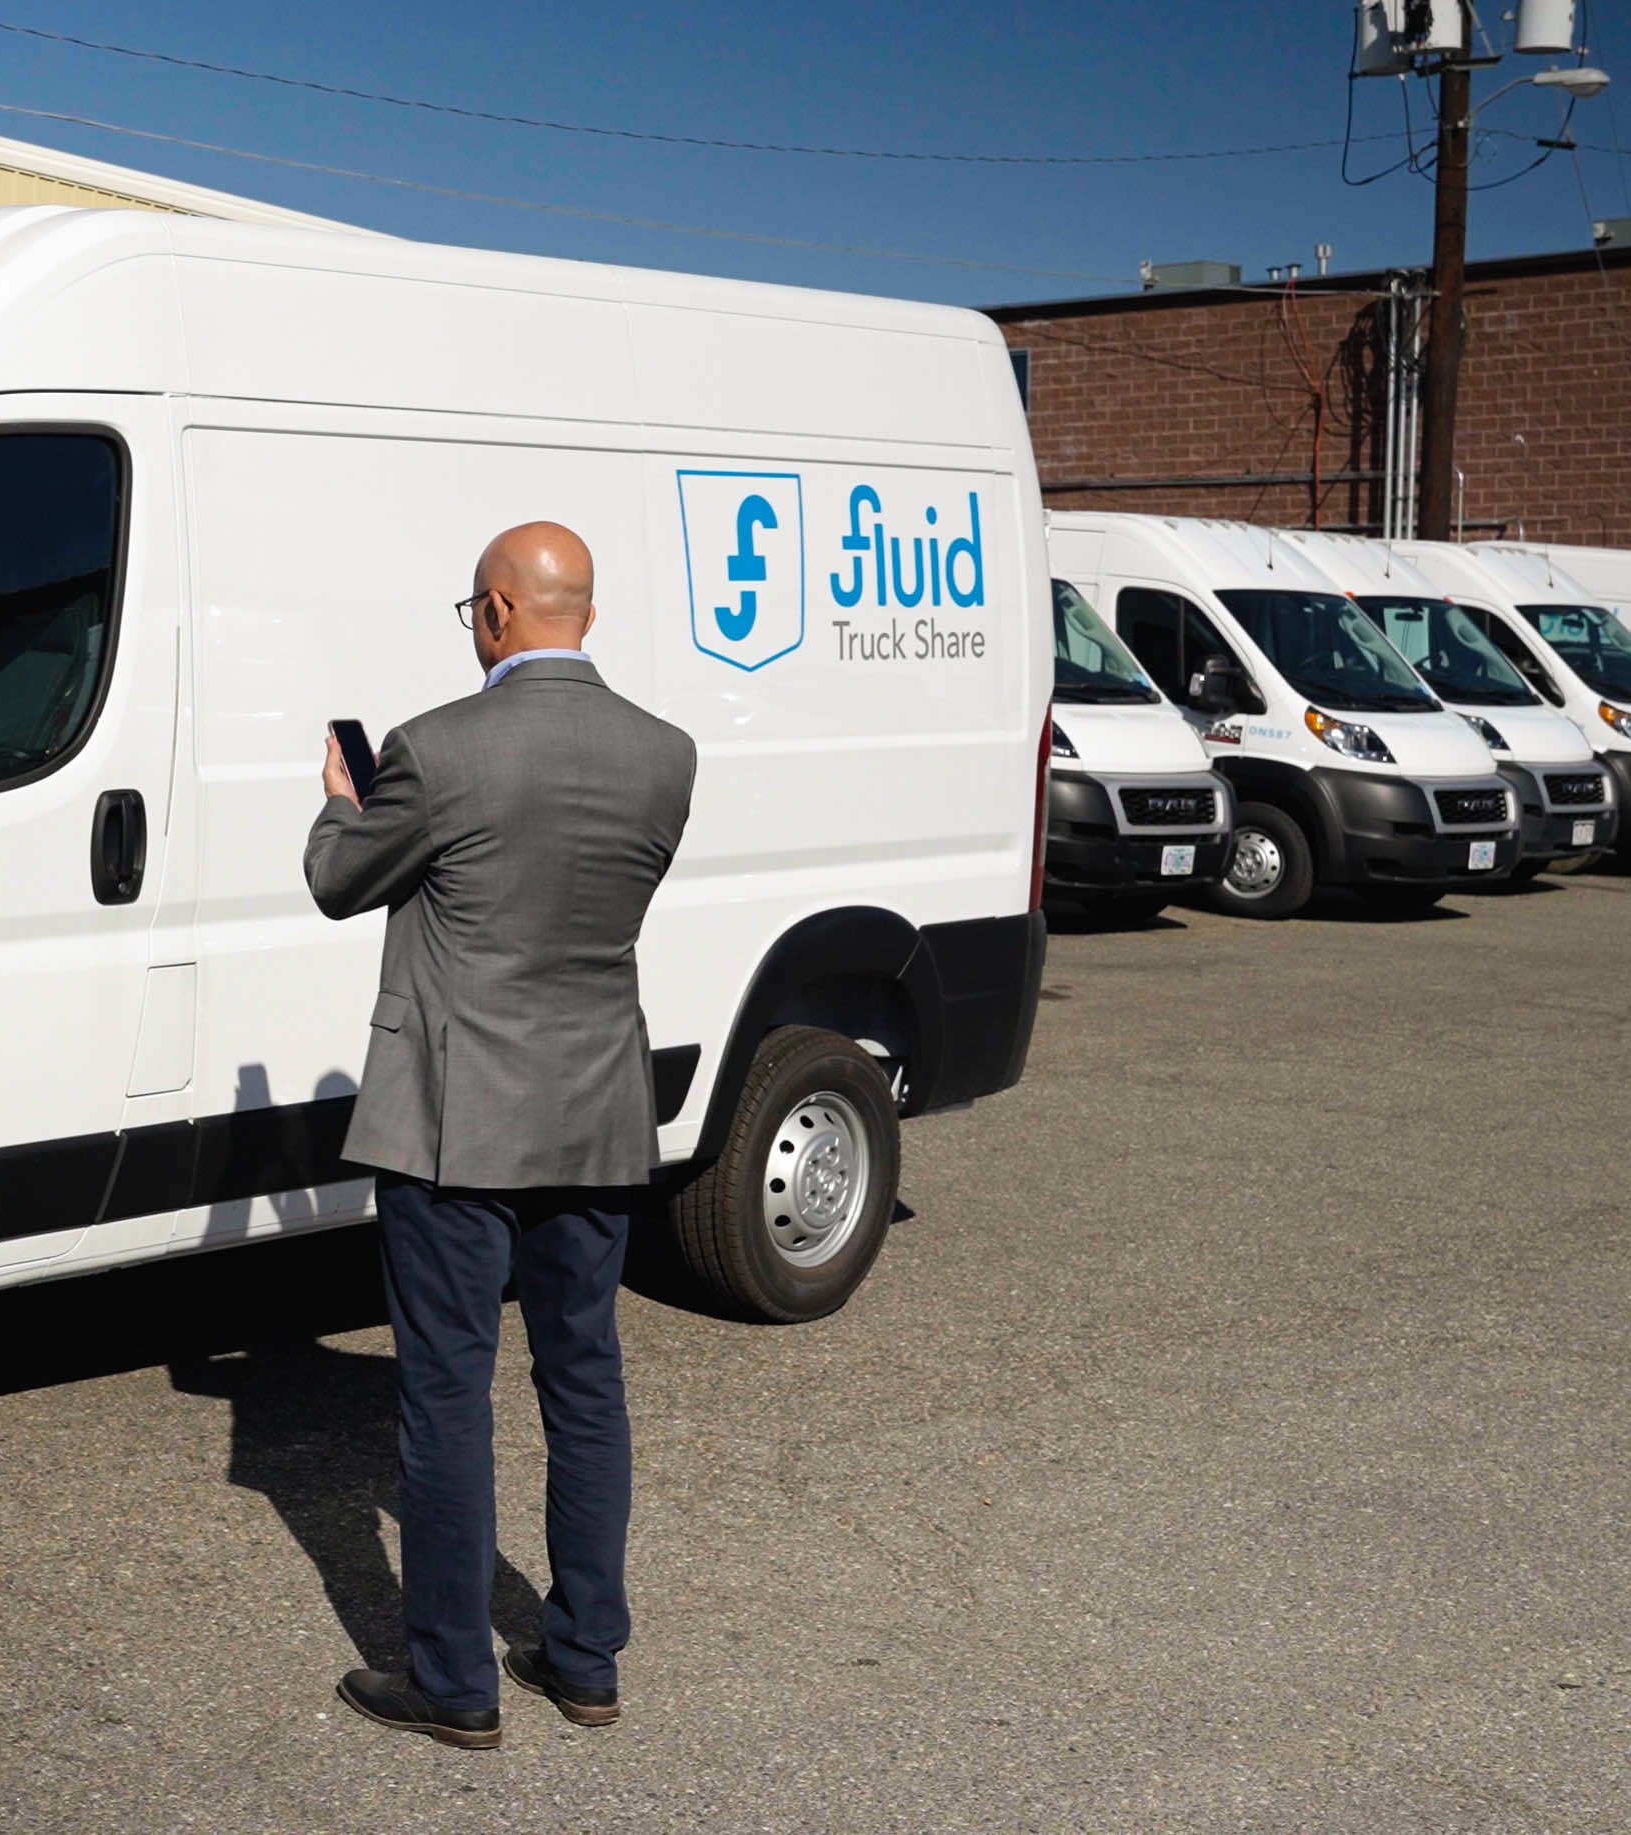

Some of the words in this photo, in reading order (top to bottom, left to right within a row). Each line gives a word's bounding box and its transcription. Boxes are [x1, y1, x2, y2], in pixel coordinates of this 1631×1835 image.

[830, 484, 985, 608] fluid
[832, 618, 906, 661] Truck
[915, 619, 985, 661] Share
